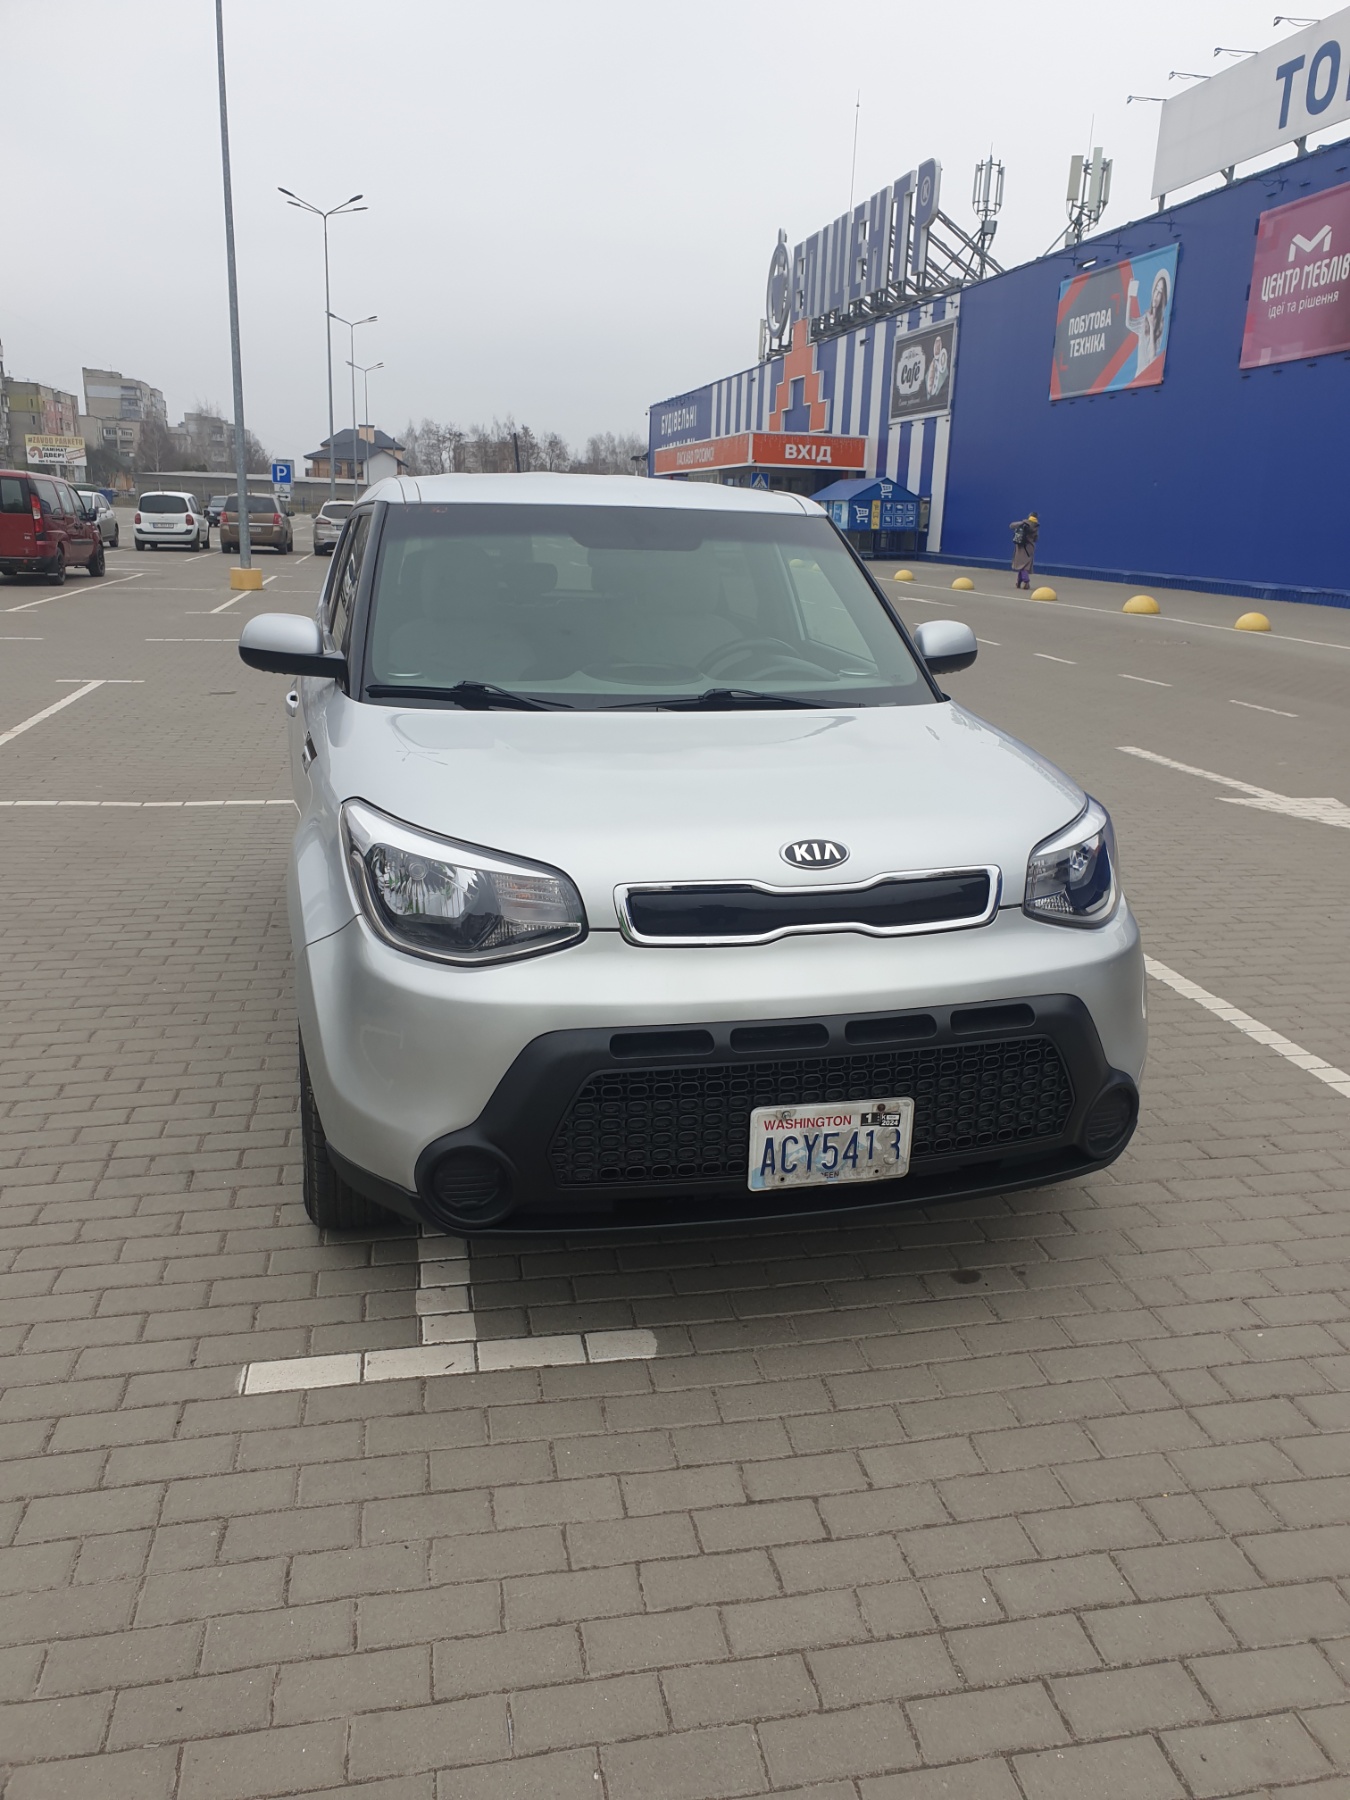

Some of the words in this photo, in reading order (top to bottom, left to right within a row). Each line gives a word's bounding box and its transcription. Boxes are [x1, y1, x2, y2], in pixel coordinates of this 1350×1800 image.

[1275, 40, 1350, 130] ТО
[1261, 266, 1300, 302] ЦЕНТР
[1301, 252, 1350, 292] МЕБЛІВ
[1268, 301, 1285, 319] ідеї
[1286, 299, 1297, 313] та
[1298, 288, 1339, 313] рішення
[1068, 308, 1112, 336] ПОБУТОВА
[1070, 333, 1105, 358] ТЕХНІКА
[901, 360, 921, 389] Café
[660, 405, 697, 437] БУДІВЕЛЬНІ
[676, 449, 694, 465] ЛАСКАВО
[784, 443, 832, 463] ВХІД
[276, 465, 287, 481] P
[792, 843, 841, 861] KIA
[764, 1115, 852, 1131] WASHINGTON
[759, 1127, 901, 1176] ACY5413
